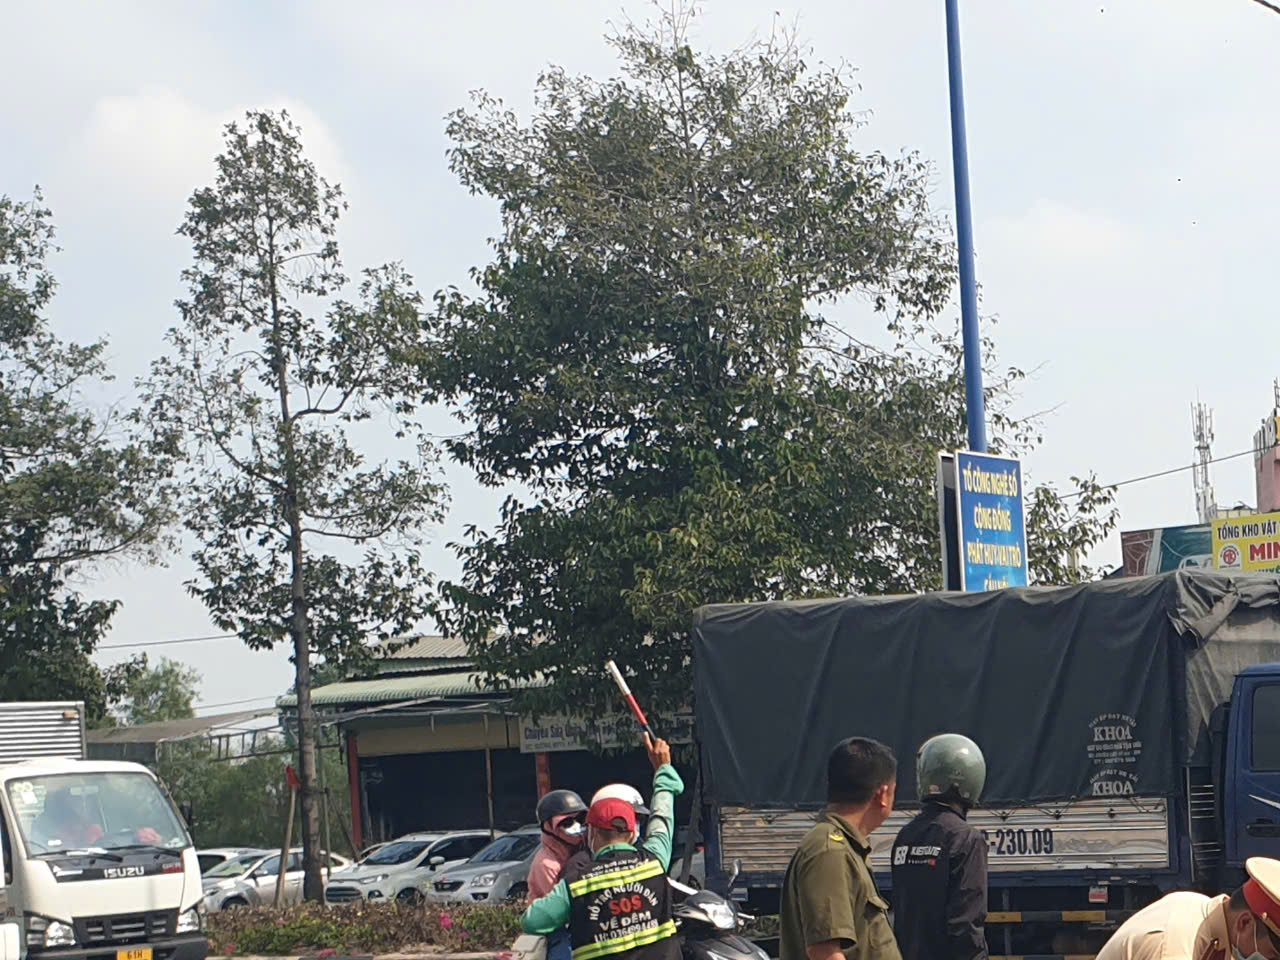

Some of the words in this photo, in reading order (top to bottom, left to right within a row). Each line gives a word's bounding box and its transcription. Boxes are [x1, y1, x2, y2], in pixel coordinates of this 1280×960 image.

[1217, 521, 1240, 541] TỔNG
[1242, 523, 1259, 538] KHO
[1261, 519, 1277, 538] VẬT
[1093, 726, 1133, 741] KHOA
[1092, 781, 1135, 796] KHOA
[103, 866, 145, 878] ISUZU
[609, 894, 642, 915] SOS
